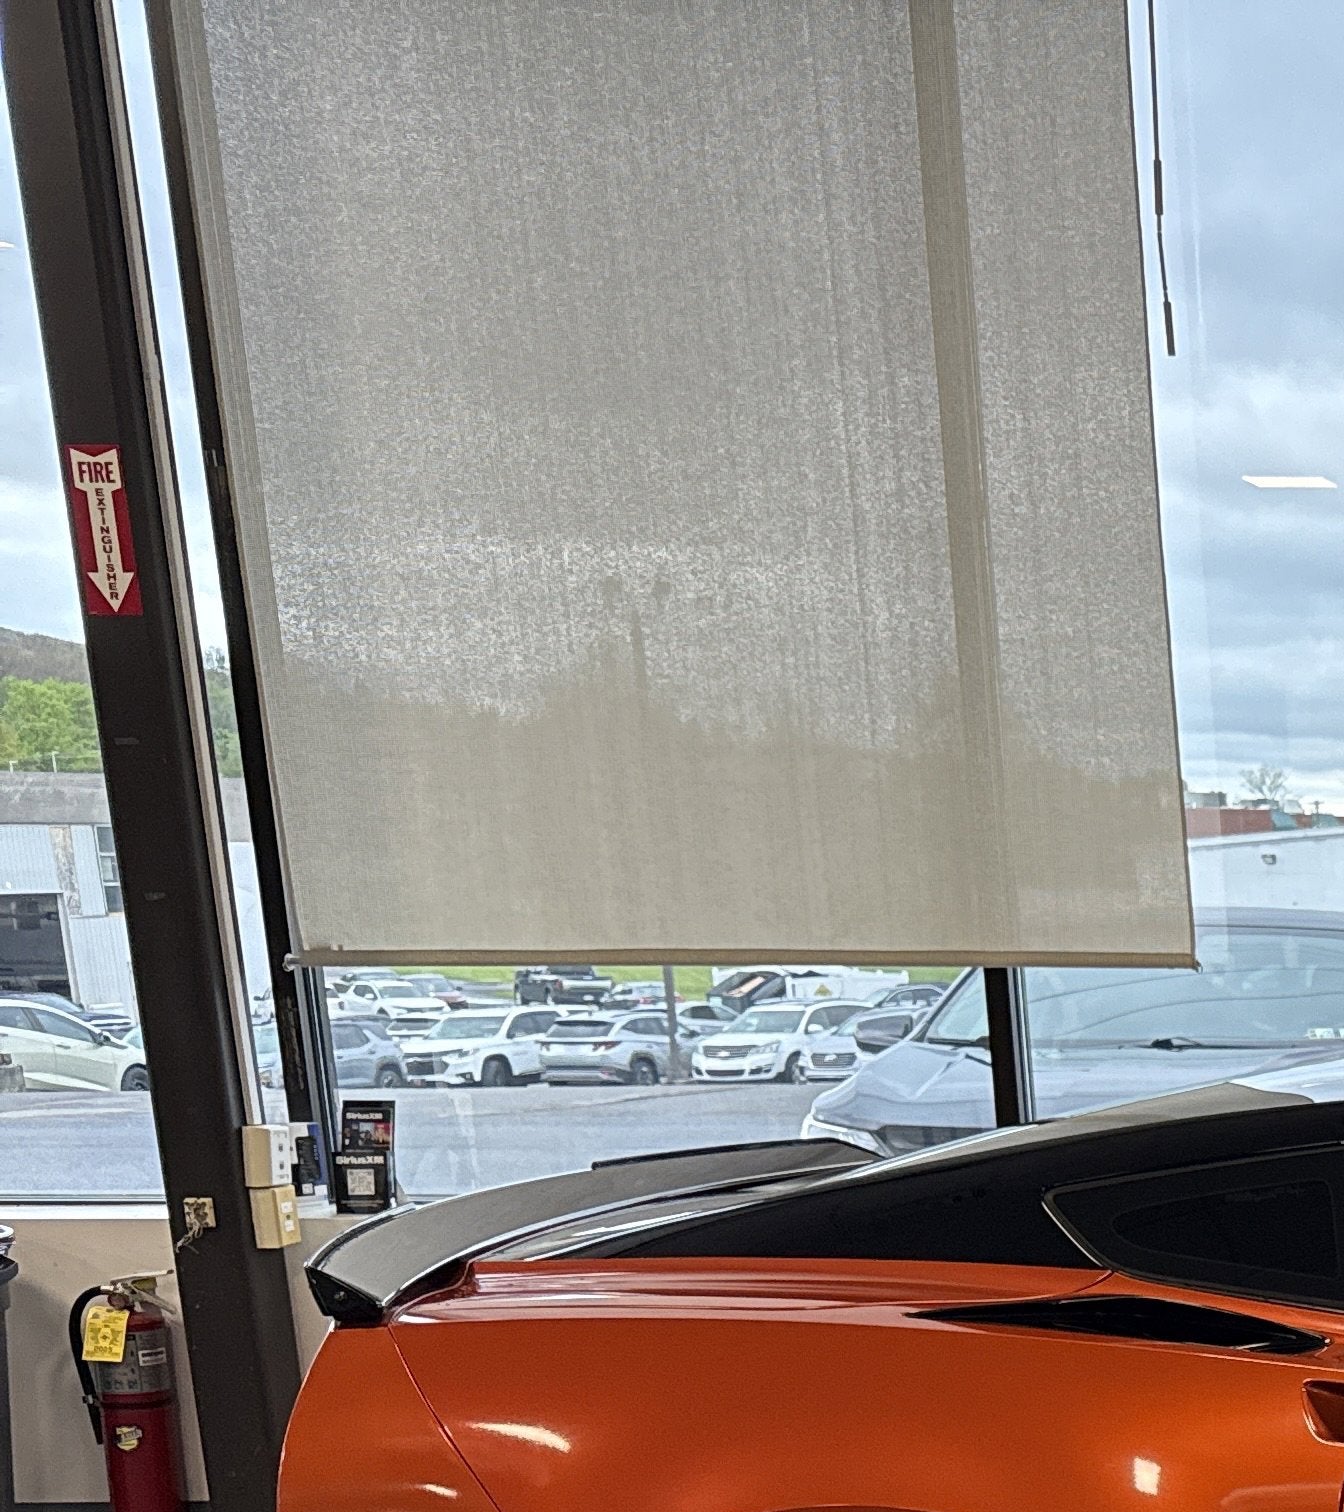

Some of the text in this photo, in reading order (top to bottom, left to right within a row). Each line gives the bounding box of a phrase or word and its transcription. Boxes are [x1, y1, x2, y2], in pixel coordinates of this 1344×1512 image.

[77, 461, 116, 484] FIRE
[95, 488, 120, 601] EXTINGUISHER
[336, 1156, 384, 1165] SiriusXM
